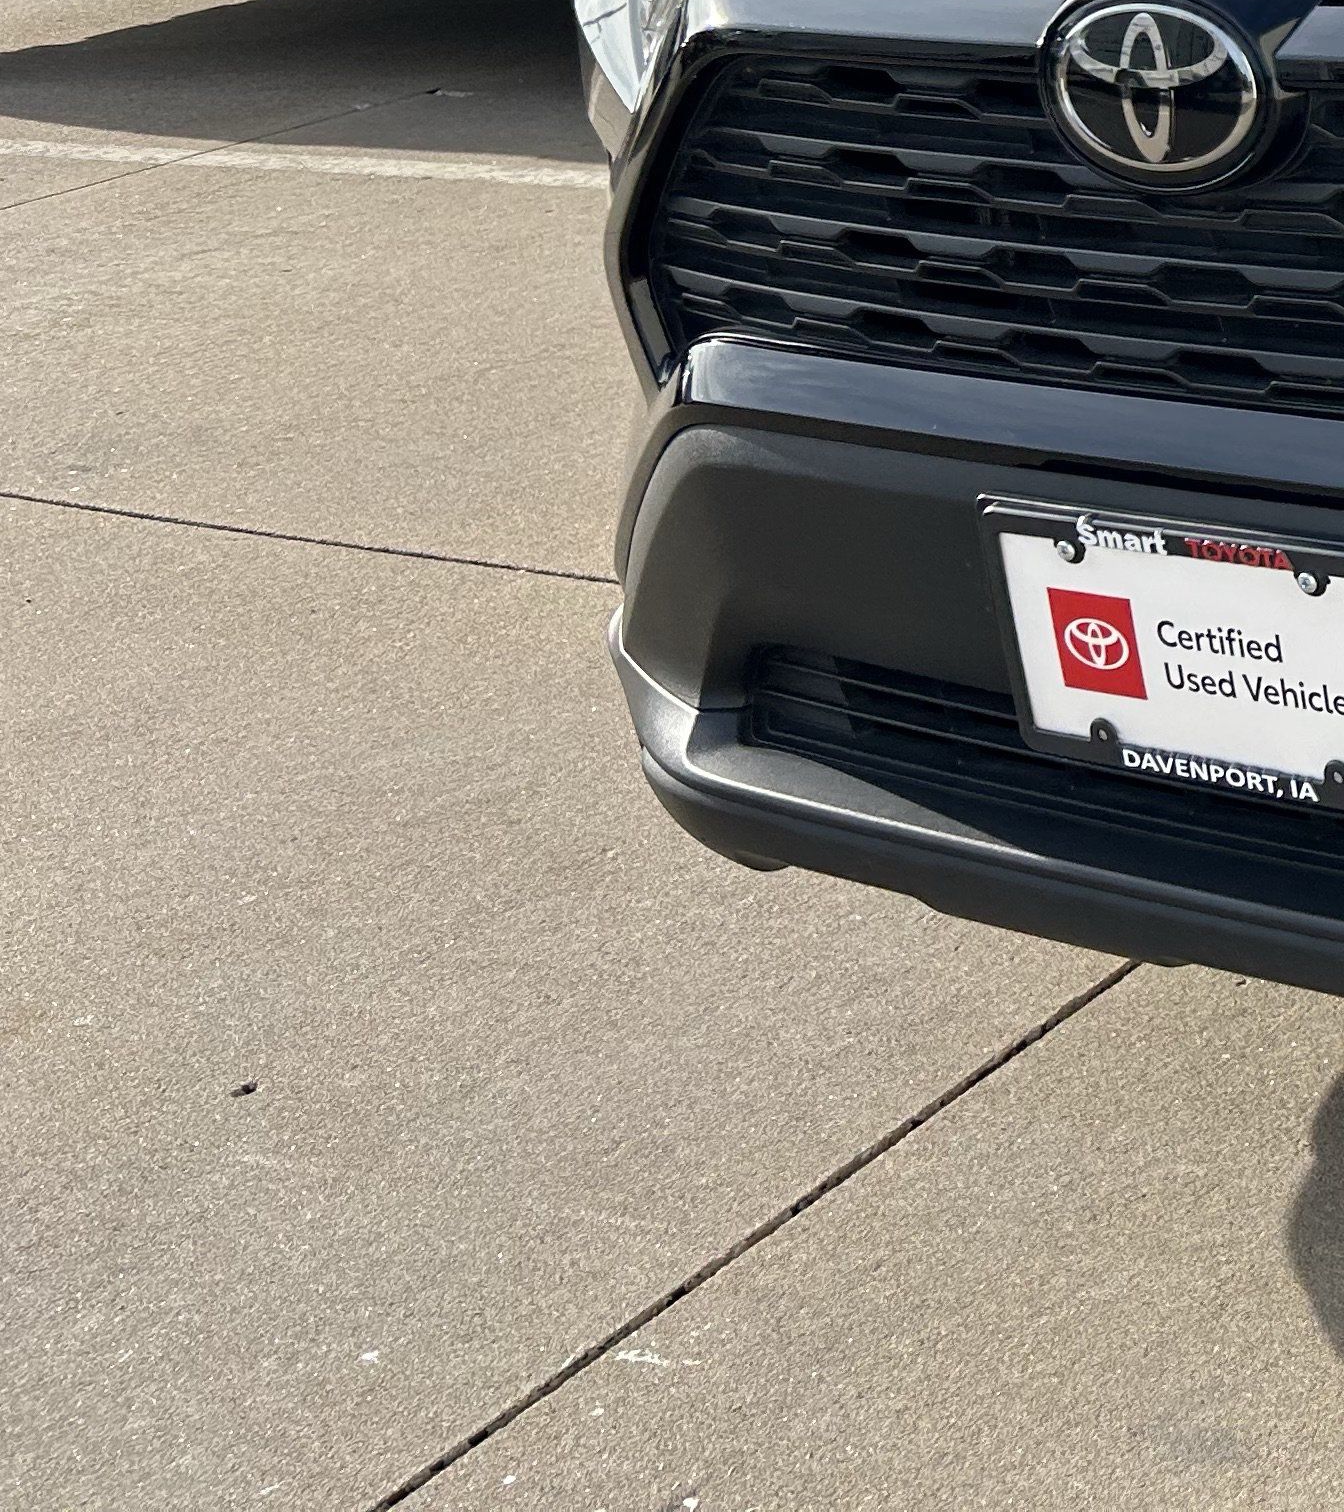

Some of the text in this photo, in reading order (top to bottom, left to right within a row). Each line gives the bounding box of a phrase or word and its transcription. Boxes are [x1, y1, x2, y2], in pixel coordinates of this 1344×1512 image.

[1077, 516, 1294, 571] Smart TOYOTA
[1156, 620, 1284, 663] Certified
[1164, 662, 1237, 699] Used
[1122, 749, 1319, 802] DAVENPORT, IA
